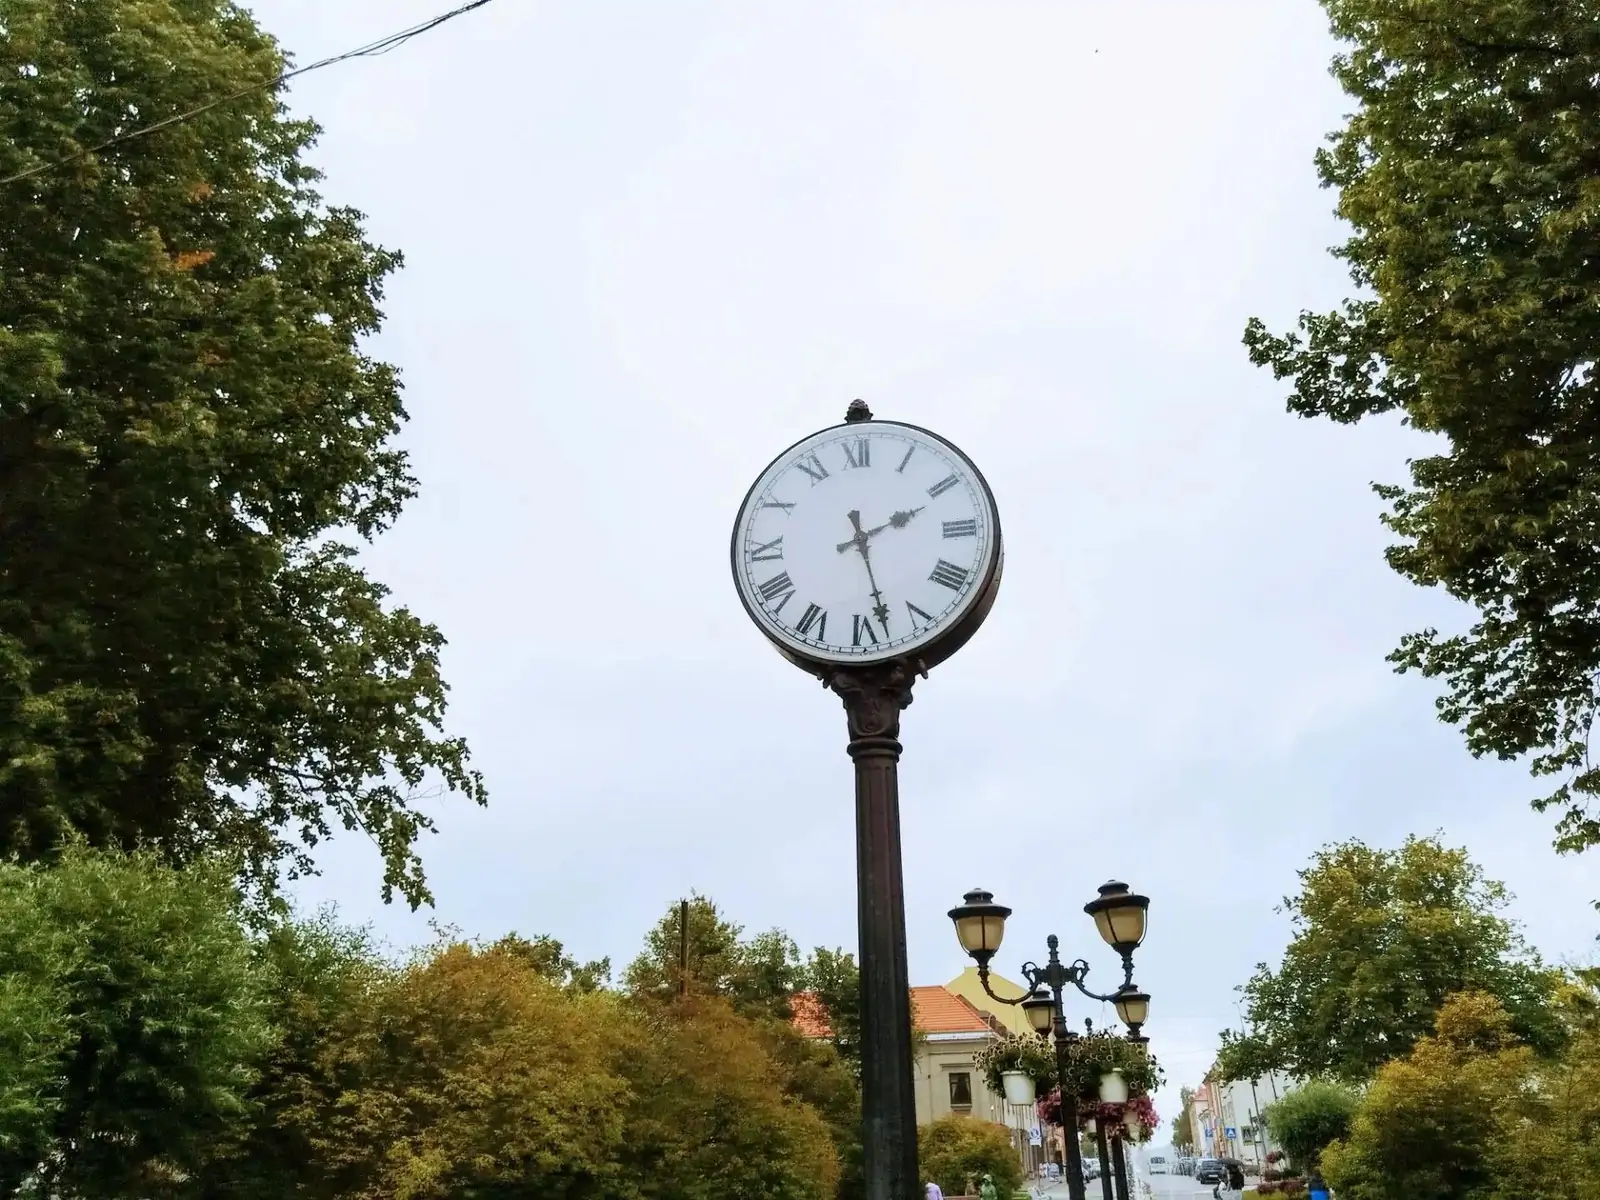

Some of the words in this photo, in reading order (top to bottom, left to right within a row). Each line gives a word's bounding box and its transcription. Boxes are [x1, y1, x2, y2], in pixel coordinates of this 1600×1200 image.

[797, 451, 831, 488] XI
[841, 439, 871, 471] XII
[895, 445, 915, 474] I
[926, 474, 960, 499] II
[761, 494, 797, 516] X
[941, 518, 977, 539] III
[750, 534, 784, 562] IX
[927, 558, 970, 592] IIII
[757, 570, 797, 616] VIII
[794, 601, 828, 642] VII
[852, 614, 880, 646] VI
[905, 600, 935, 630] V
